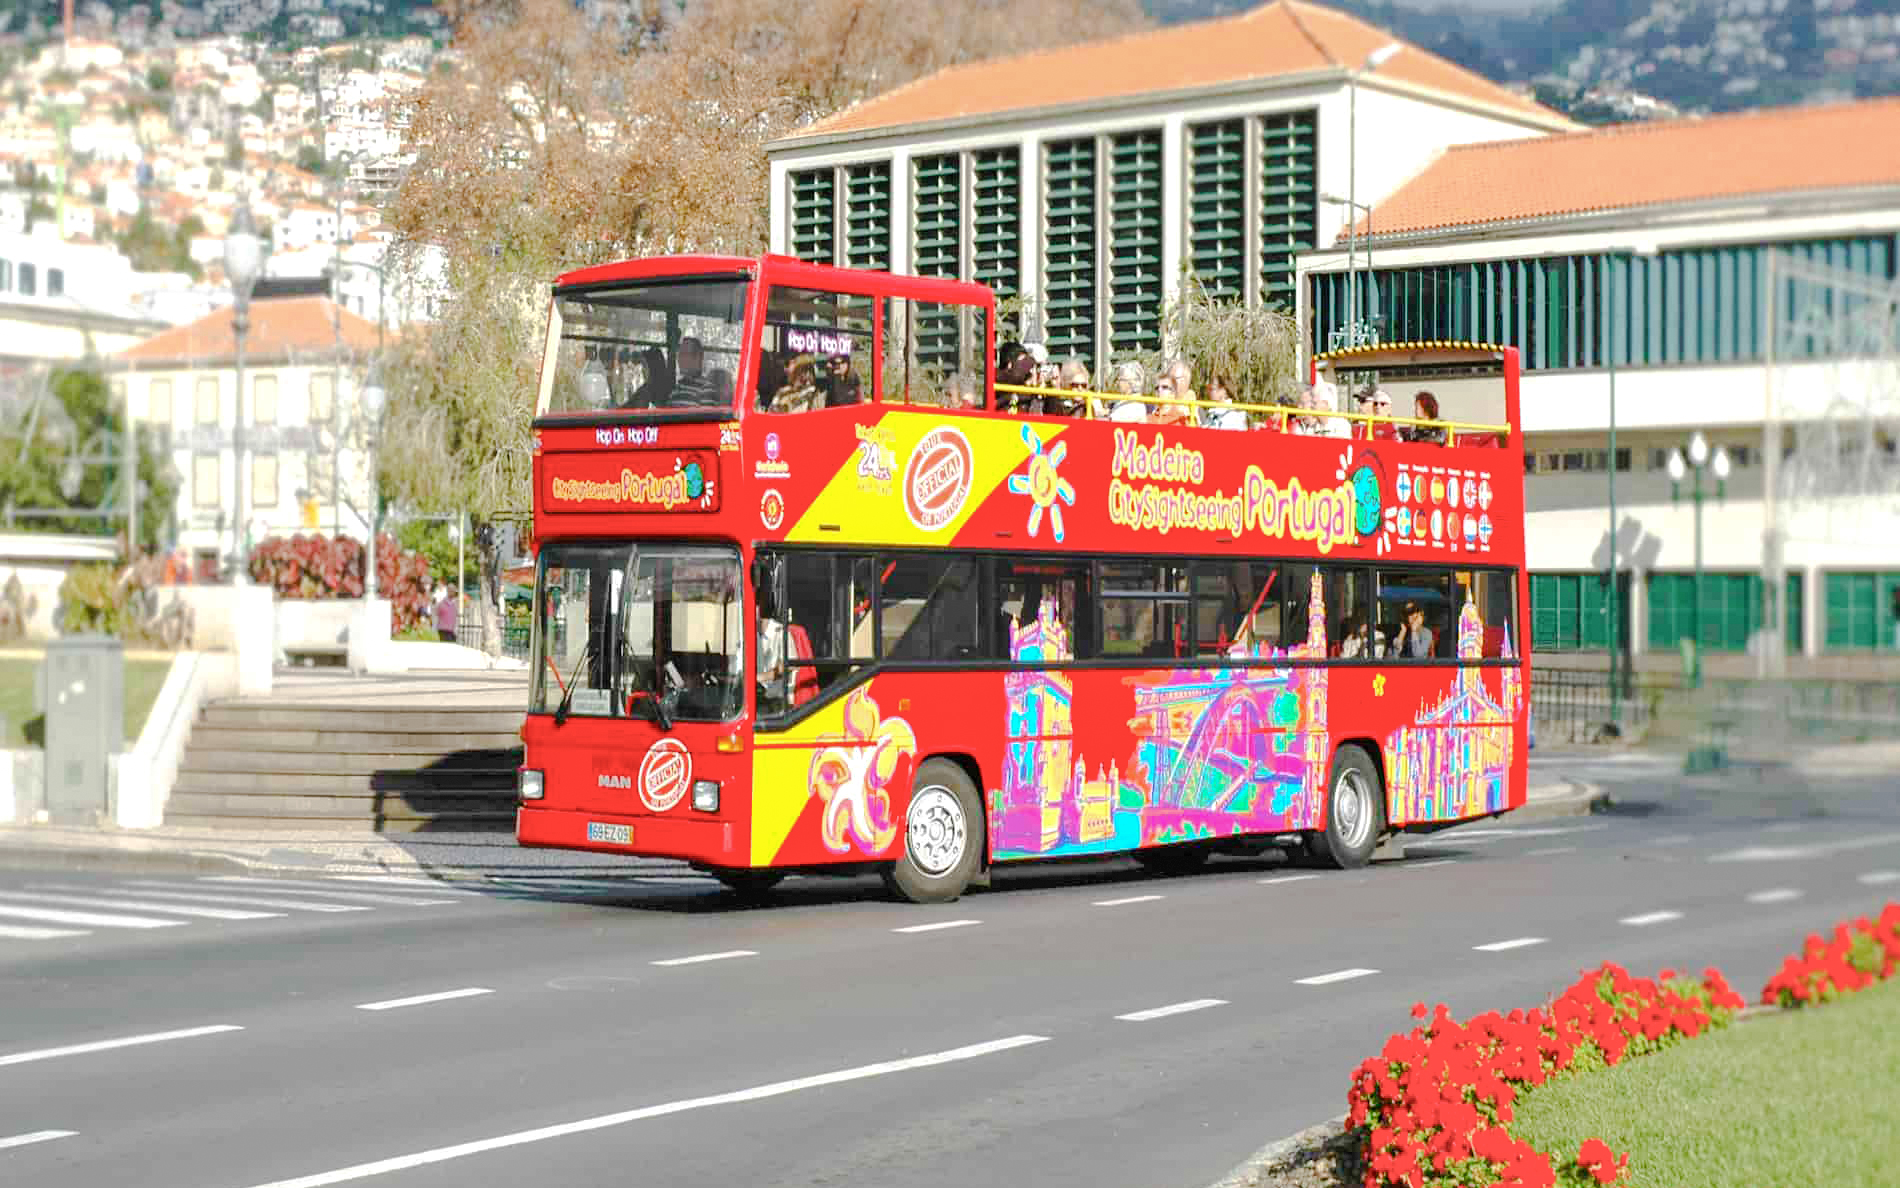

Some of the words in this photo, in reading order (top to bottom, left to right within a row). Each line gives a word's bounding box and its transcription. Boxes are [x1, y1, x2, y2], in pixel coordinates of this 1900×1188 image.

[595, 428, 612, 446] Hop
[628, 427, 644, 446] Hop
[1111, 427, 1204, 485] Madeira
[621, 468, 689, 510] Portugal
[1108, 478, 1243, 538] CitySightseeing
[1244, 464, 1356, 555] Portugal
[598, 774, 632, 789] MAN
